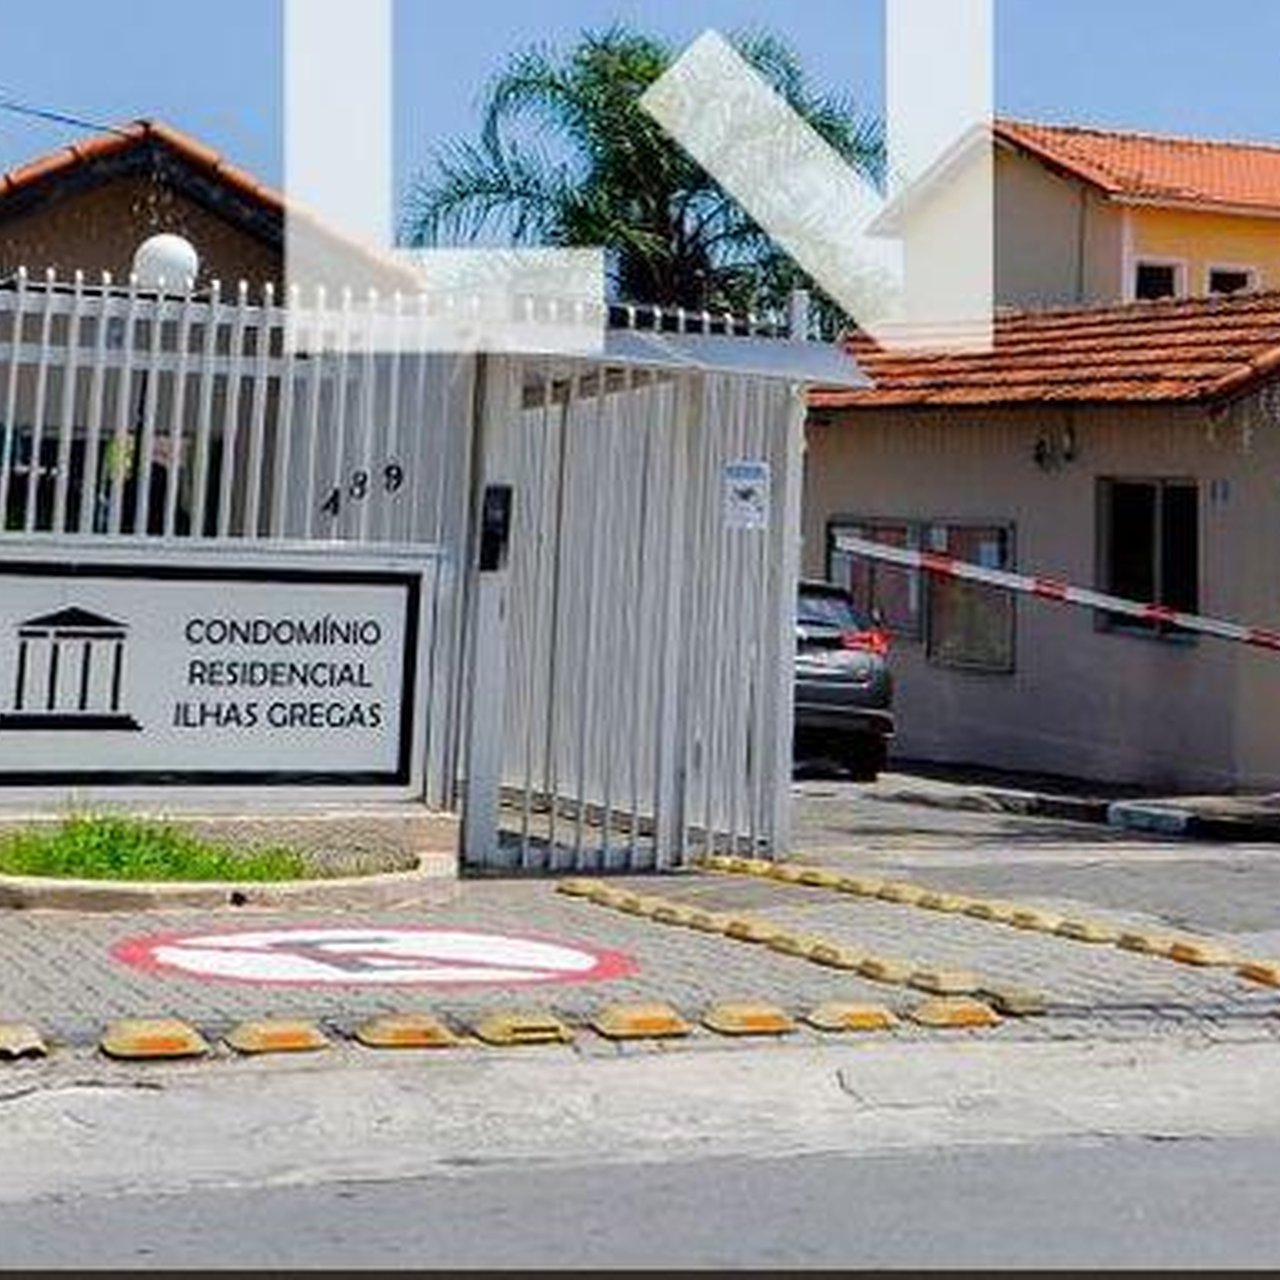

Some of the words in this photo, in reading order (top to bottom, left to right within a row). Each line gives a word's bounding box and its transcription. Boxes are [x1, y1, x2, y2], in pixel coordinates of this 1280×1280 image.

[184, 613, 382, 646] CONDOMÍNIO
[187, 658, 373, 688] RESIDENCIAL
[172, 701, 259, 728] ILHAS
[266, 702, 382, 728] GREGAS
